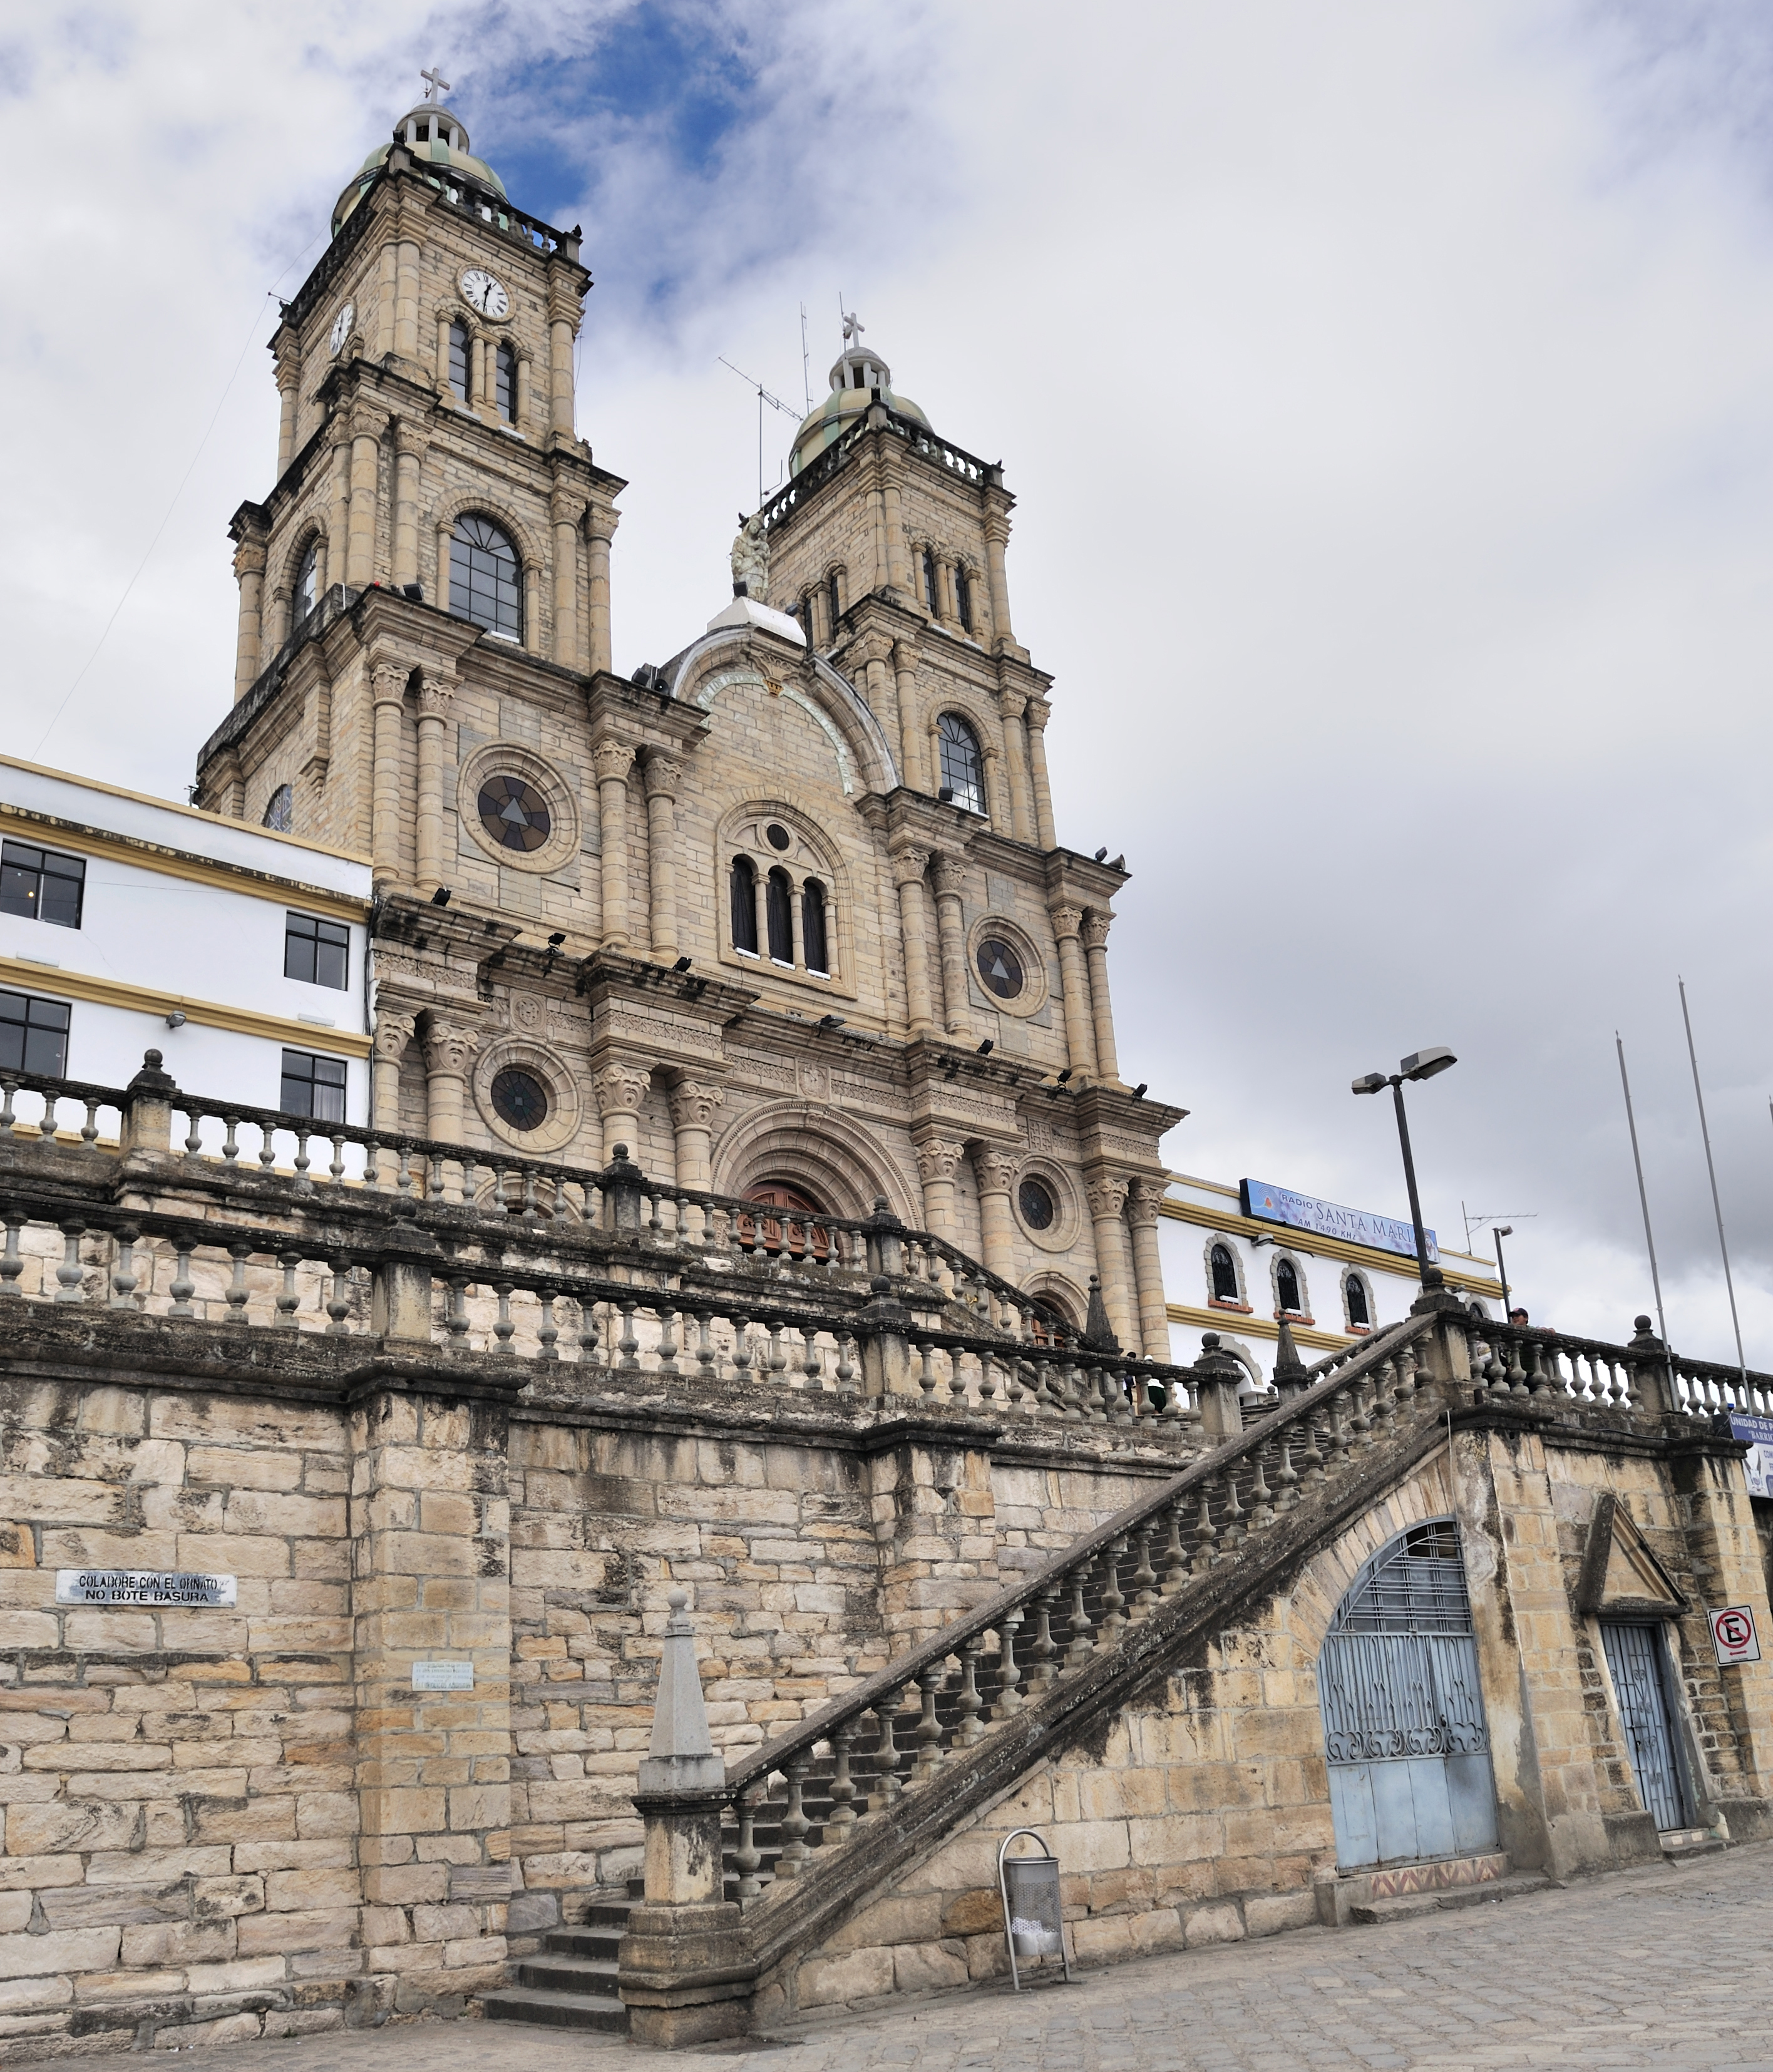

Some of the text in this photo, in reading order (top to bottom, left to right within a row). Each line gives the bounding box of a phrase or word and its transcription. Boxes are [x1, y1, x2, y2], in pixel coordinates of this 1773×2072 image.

[1282, 1194, 1416, 1244] RADIO SANTA MARÍ
[1298, 1218, 1311, 1228] AM
[1315, 1223, 1337, 1235] 1490
[1730, 1417, 1757, 1428] UNIDAD
[1759, 1421, 1768, 1430] DE
[80, 1575, 217, 1590] COLABORE CON EL ORNATO
[86, 1590, 208, 1602] NO BOTE BASURA
[1725, 1617, 1743, 1643] E
